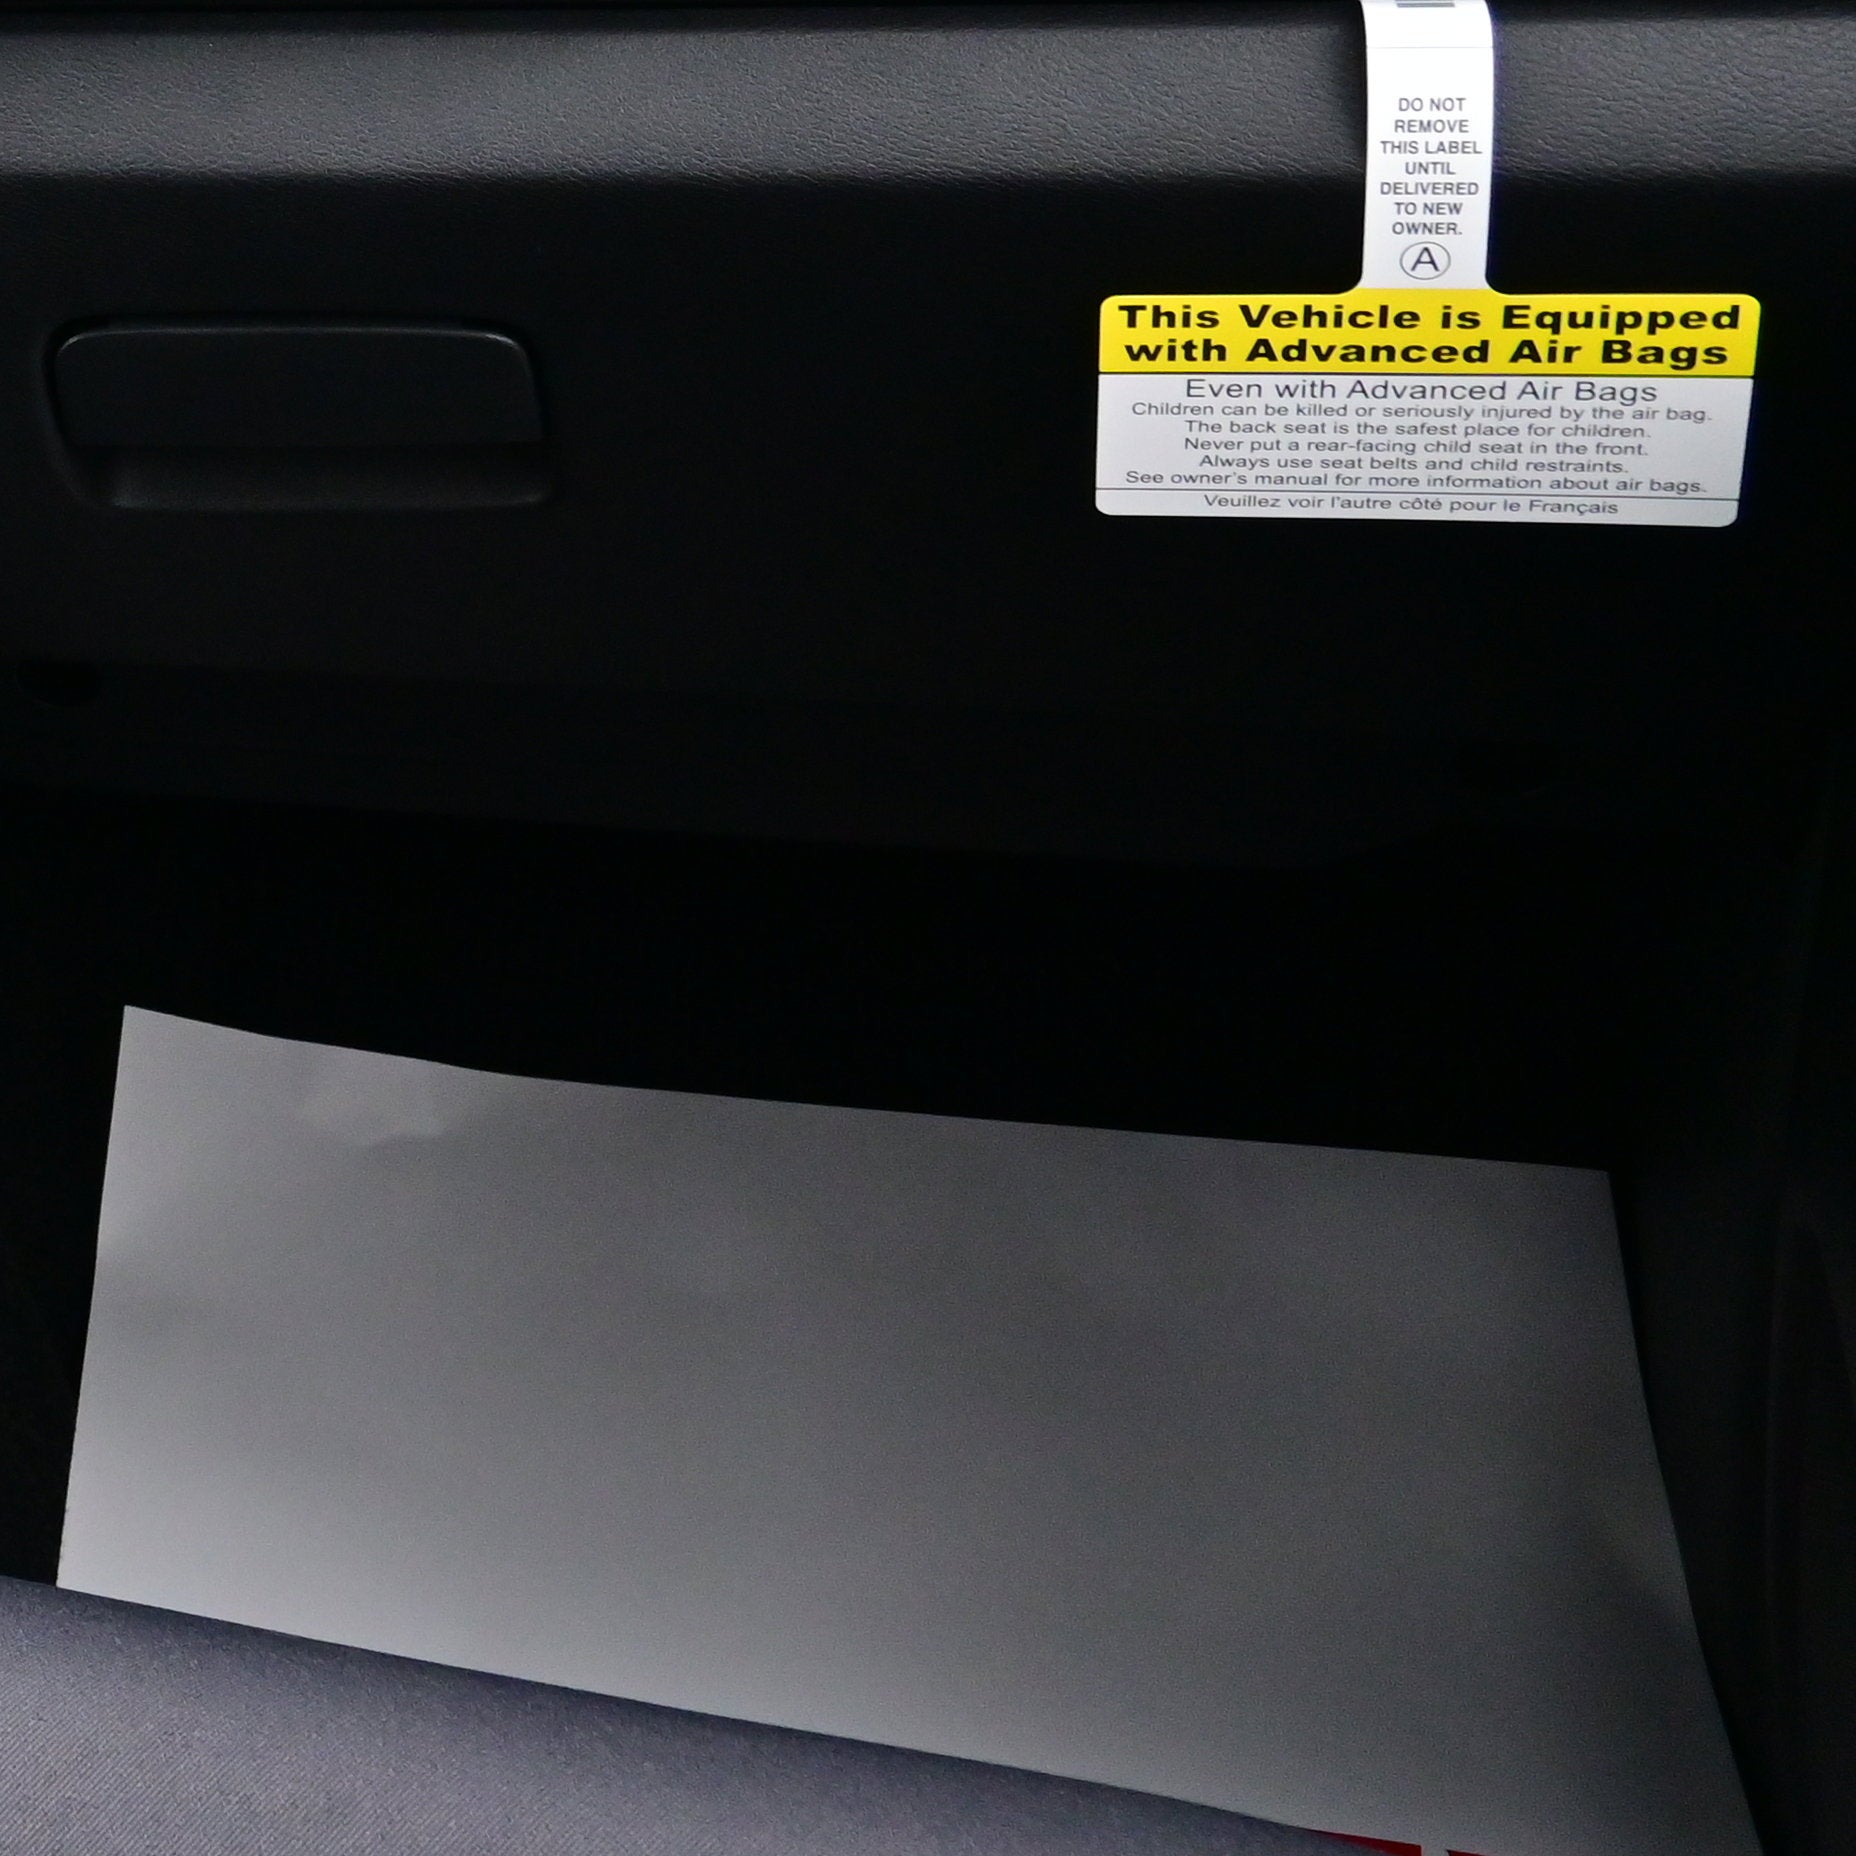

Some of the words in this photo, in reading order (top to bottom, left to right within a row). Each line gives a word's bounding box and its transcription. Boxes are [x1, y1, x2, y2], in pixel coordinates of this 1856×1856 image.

[1399, 98, 1423, 111] DO
[1430, 98, 1466, 111] NOT
[1394, 119, 1469, 133] REMOVE
[1380, 141, 1419, 154] THIS
[1425, 141, 1482, 154] LABEL
[1405, 162, 1456, 175] UNTIL
[1380, 182, 1478, 195] DELIVERED
[1394, 202, 1416, 215] TO
[1423, 202, 1463, 215] NEW
[1392, 222, 1463, 235] OWNER.
[1119, 304, 1219, 329] This
[1239, 304, 1421, 329] Vehicle
[1441, 305, 1481, 330] is
[1503, 305, 1740, 335] Equipped
[1124, 338, 1227, 362] with
[1246, 338, 1490, 363] Advanced
[1509, 340, 1582, 364] Air
[1601, 340, 1728, 371] Bags
[1186, 378, 1262, 398] Even
[1275, 379, 1336, 399] with
[1346, 379, 1507, 401] Advanced
[1517, 381, 1563, 401] Air
[1575, 381, 1658, 406] Bags
[1132, 402, 1214, 416] Children
[1222, 405, 1257, 416] can
[1265, 404, 1288, 416] be
[1296, 404, 1347, 417] killed
[1355, 406, 1376, 418] or
[1383, 405, 1474, 421] seriously
[1482, 406, 1551, 421] injured
[1560, 407, 1583, 422] by
[1592, 407, 1624, 420] the
[1632, 408, 1659, 421] air
[1667, 408, 1713, 424] bag.
[1185, 419, 1222, 433] The
[1230, 420, 1276, 434] back
[1284, 422, 1325, 434] seat
[1333, 422, 1349, 435] is
[1357, 423, 1388, 435] the
[1395, 422, 1459, 438] safest
[1464, 424, 1520, 439] place
[1528, 424, 1555, 438] for
[1562, 424, 1651, 438] children.
[1184, 438, 1244, 451] Never
[1251, 439, 1288, 453] put
[1291, 441, 1299, 452] a
[1307, 438, 1416, 455] rear-facing
[1424, 441, 1471, 454] child
[1479, 443, 1523, 455] seat
[1530, 442, 1547, 455] in
[1556, 443, 1587, 456] the
[1595, 443, 1648, 457] front.
[1200, 455, 1270, 471] Always
[1277, 458, 1313, 469] use
[1320, 457, 1363, 470] seat
[1370, 456, 1418, 470] belts
[1425, 458, 1462, 471] and
[1470, 458, 1518, 472] child
[1526, 460, 1628, 474] restraints.
[1126, 471, 1163, 484] See
[1171, 472, 1247, 485] owner's
[1255, 472, 1327, 486] manual
[1336, 473, 1362, 486] for
[1369, 476, 1419, 487] more
[1428, 475, 1541, 490] information
[1550, 477, 1608, 491] about
[1616, 479, 1643, 492] air
[1650, 479, 1706, 495] bags.
[1205, 494, 1280, 508] Veuillez
[1288, 496, 1324, 509] voir
[1332, 496, 1392, 510] l'autre
[1399, 495, 1442, 511] côté
[1450, 501, 1496, 514] pour
[1504, 499, 1520, 513] le
[1529, 499, 1618, 516] Français
